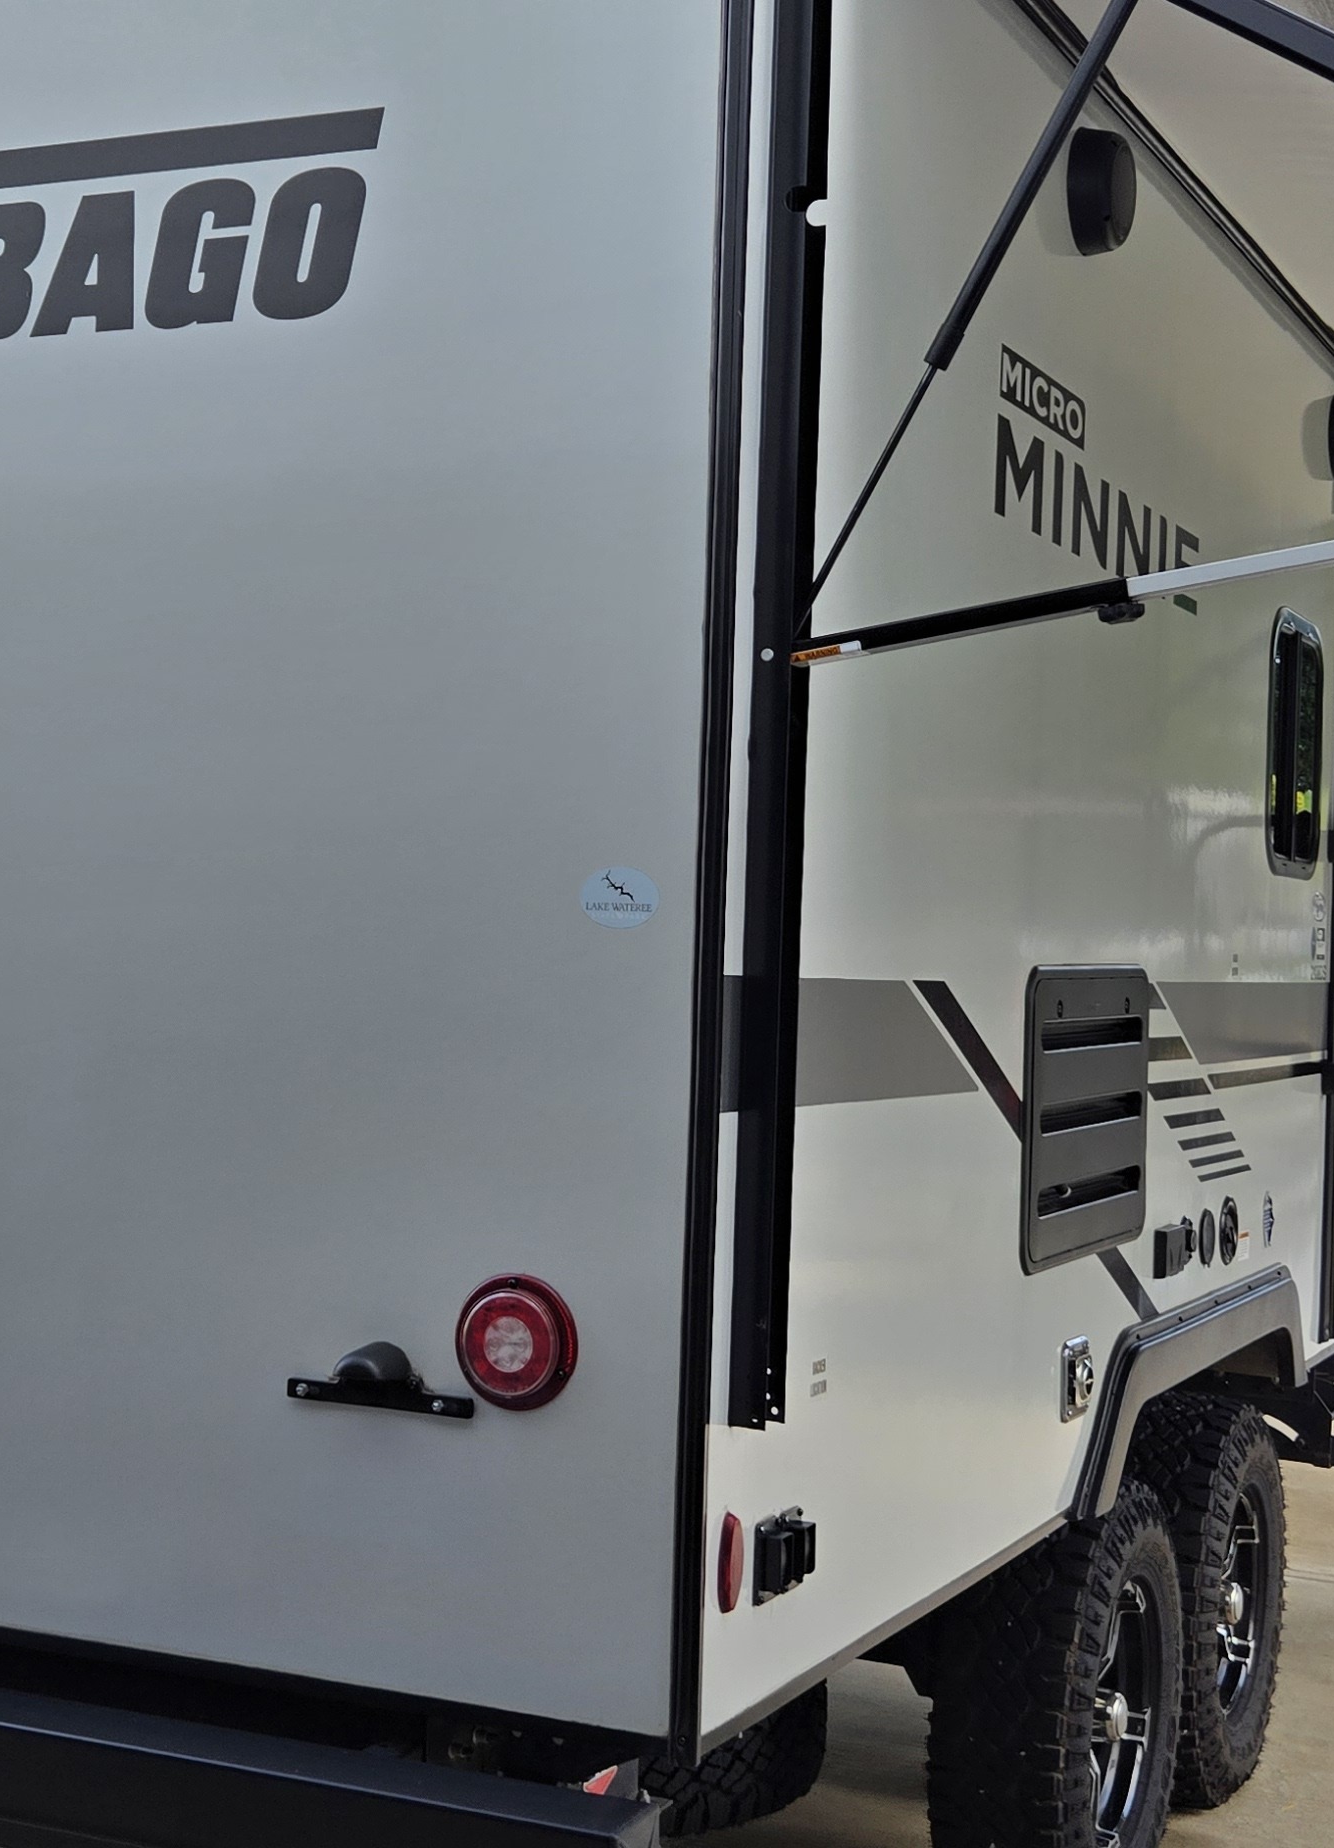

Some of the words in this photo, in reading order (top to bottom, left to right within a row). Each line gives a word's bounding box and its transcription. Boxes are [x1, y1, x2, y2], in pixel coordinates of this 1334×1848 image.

[1001, 351, 1084, 440] MICRO
[994, 413, 1200, 615] MINNIE
[585, 902, 610, 912] LAKE
[611, 902, 653, 913] WATEREE
